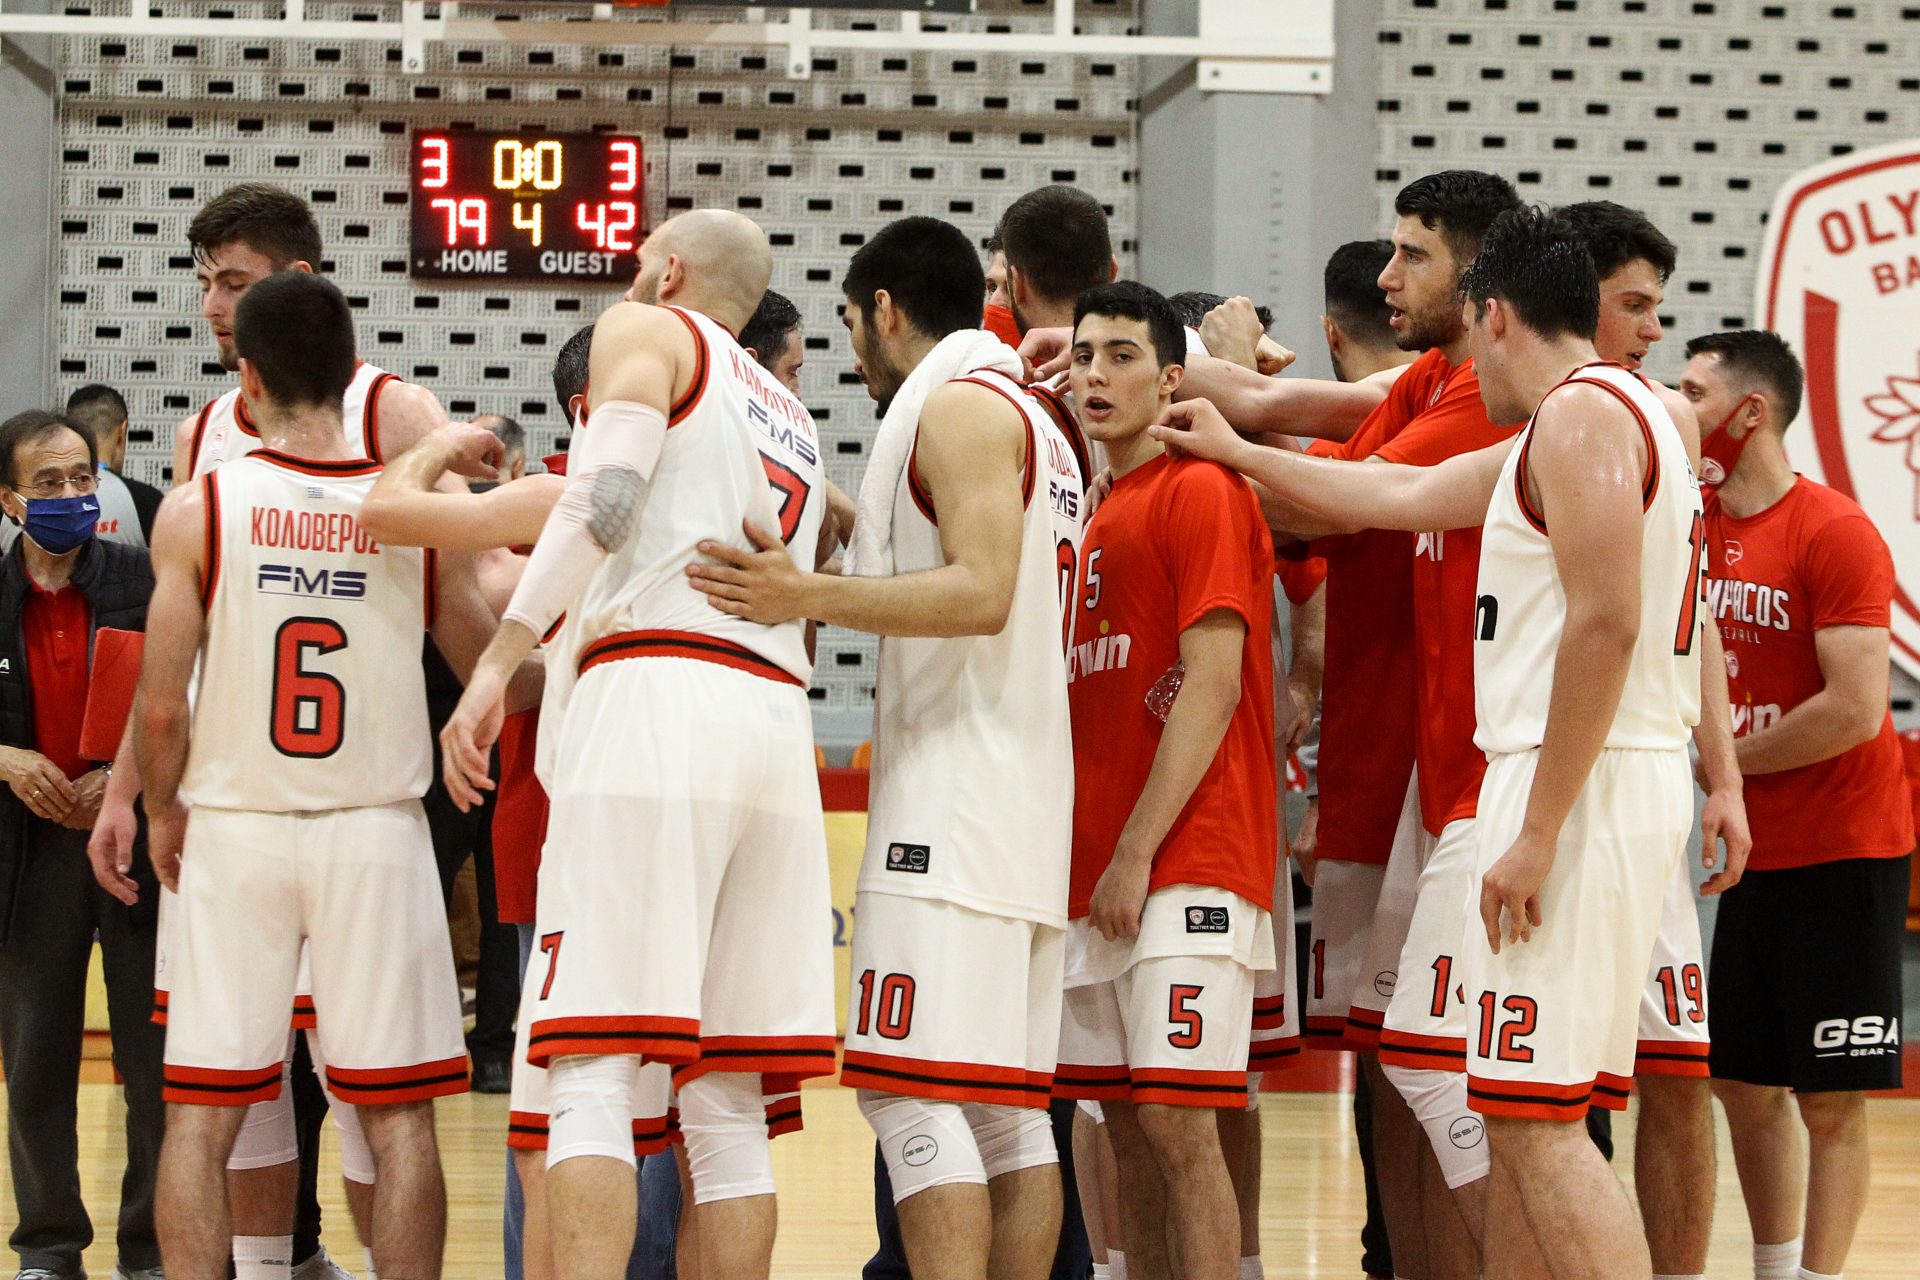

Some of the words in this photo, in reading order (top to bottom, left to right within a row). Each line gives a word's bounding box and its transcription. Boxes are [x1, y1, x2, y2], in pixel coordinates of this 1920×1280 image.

[422, 138, 448, 187] 3
[610, 142, 636, 191] 3
[430, 198, 487, 246] 79
[512, 202, 542, 247] 4
[577, 201, 636, 250] 42
[441, 250, 508, 273] HOME
[540, 252, 617, 275] GUEST
[757, 447, 811, 546] 7
[257, 563, 368, 598] FMS
[1085, 547, 1102, 613] 5
[269, 616, 348, 759] 6
[540, 930, 564, 1000] 7
[1655, 963, 1705, 1027] 19
[856, 968, 916, 1040] 10
[1168, 983, 1205, 1049] 5
[1477, 990, 1538, 1063] 12
[1813, 1015, 1898, 1049] GSA
[1849, 1047, 1885, 1057] GEAR
